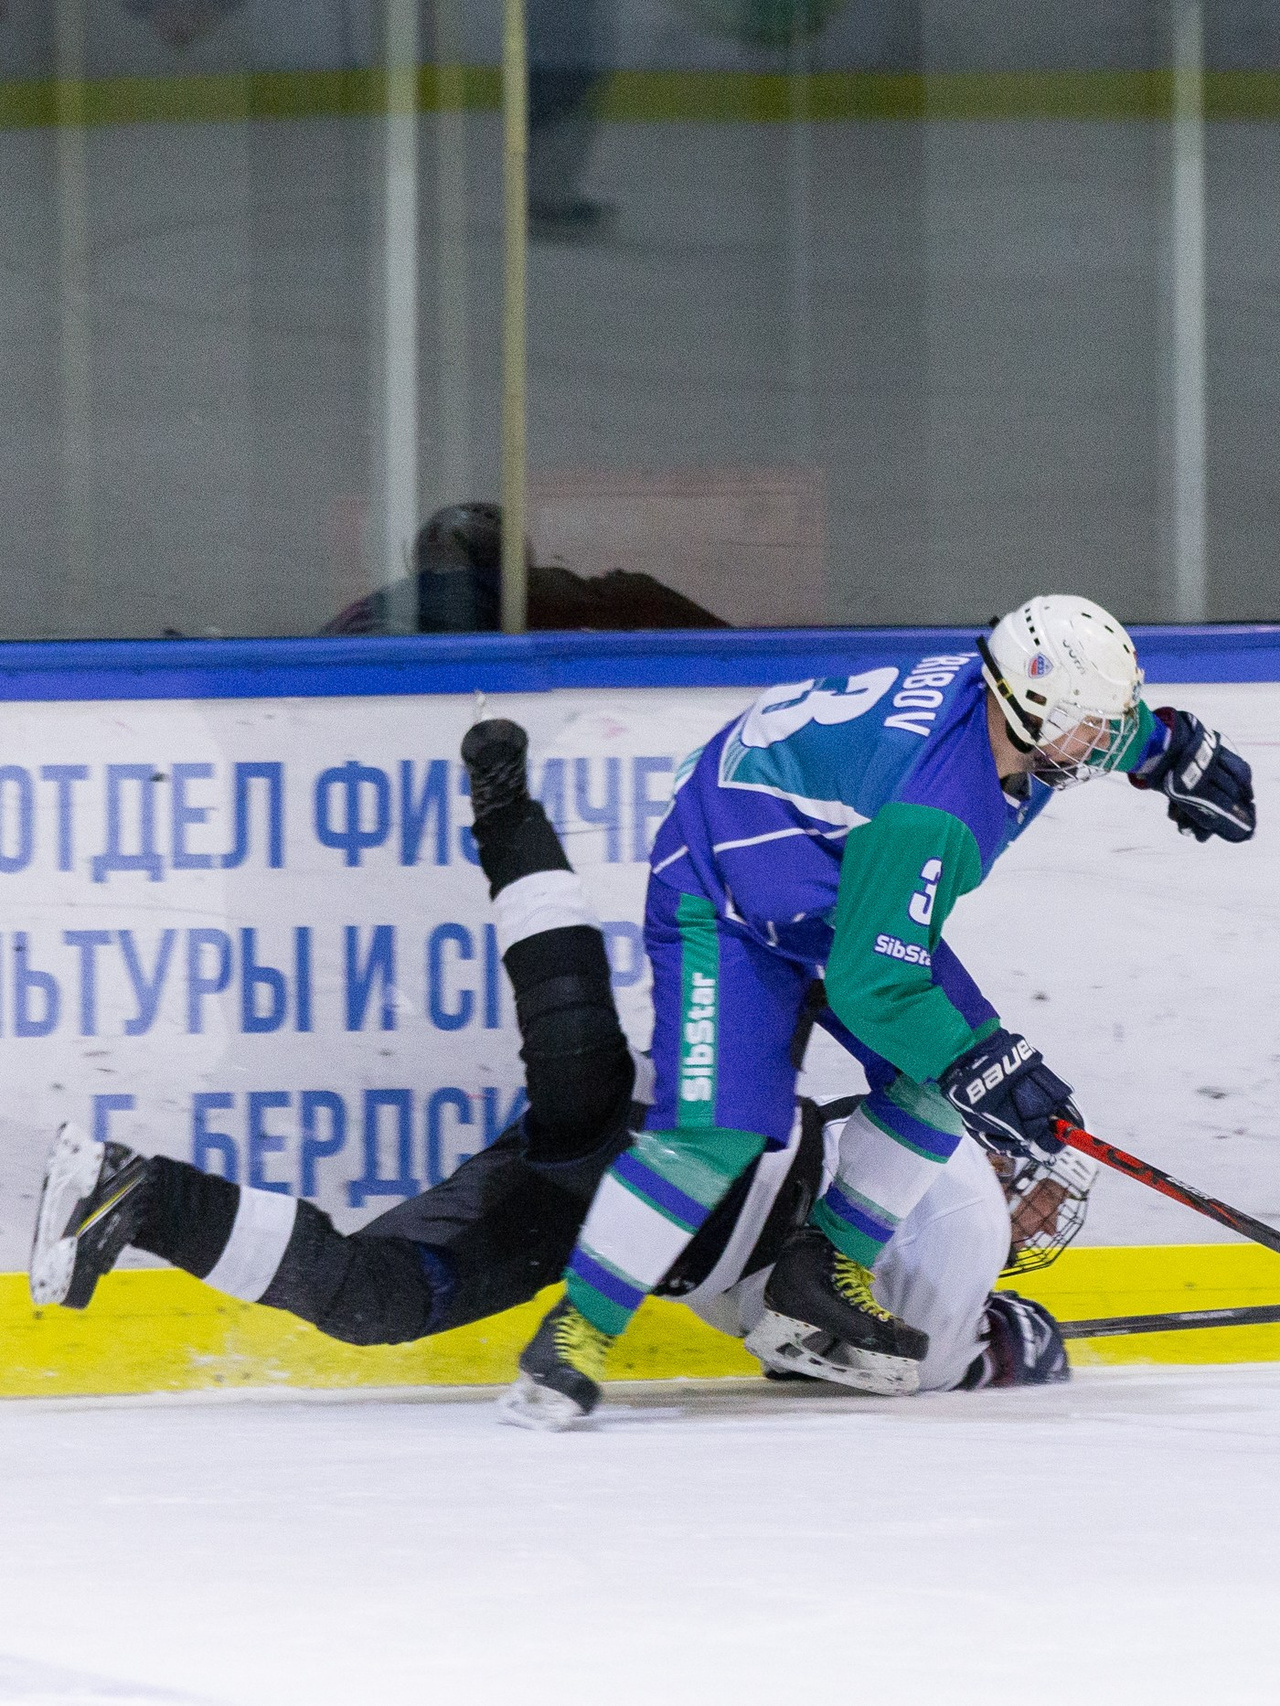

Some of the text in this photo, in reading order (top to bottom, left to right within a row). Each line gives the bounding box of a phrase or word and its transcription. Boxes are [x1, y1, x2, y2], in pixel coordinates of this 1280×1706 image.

[884, 652, 979, 737] RIBOV
[0, 762, 285, 883] ОТДЕЛ
[0, 926, 313, 1038] ЬТУРЫ
[346, 924, 396, 1031] И
[681, 972, 717, 1102] SibStar
[966, 1039, 1036, 1105] BAUE
